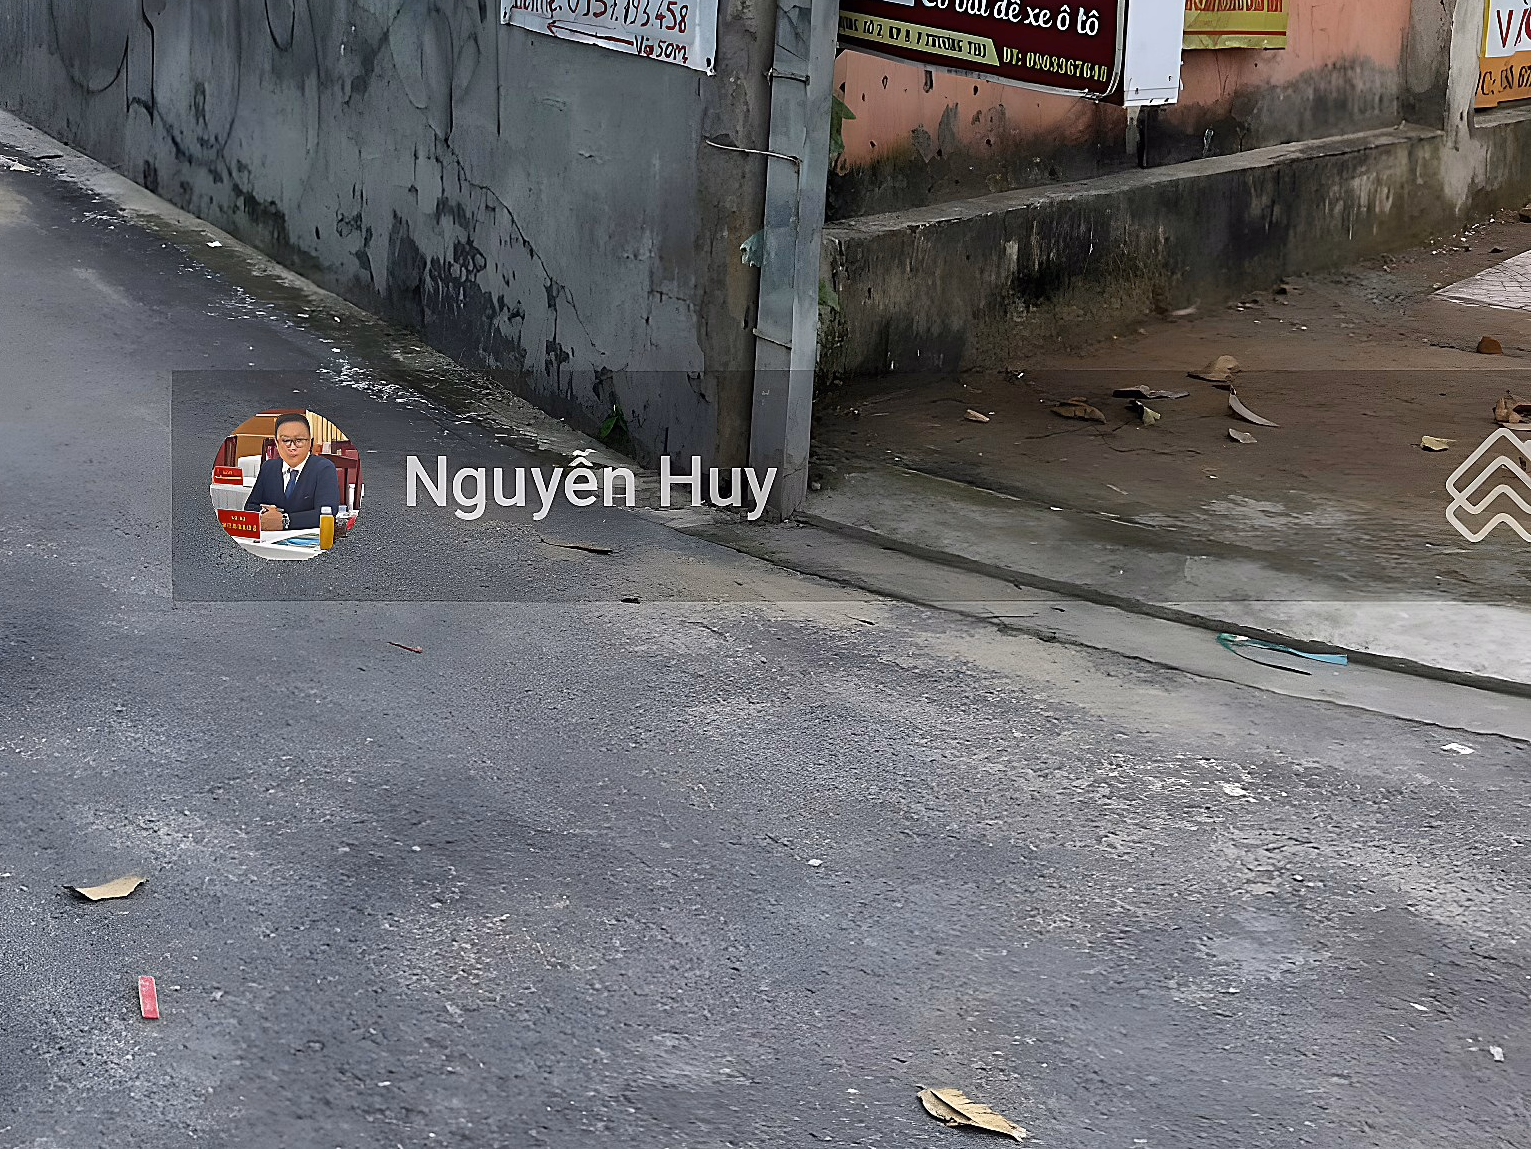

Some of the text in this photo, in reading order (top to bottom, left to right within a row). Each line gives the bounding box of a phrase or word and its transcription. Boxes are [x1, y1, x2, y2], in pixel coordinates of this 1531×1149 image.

[1024, 6, 1052, 28] xe
[1057, 4, 1070, 31] ô
[1077, 7, 1100, 35] tô
